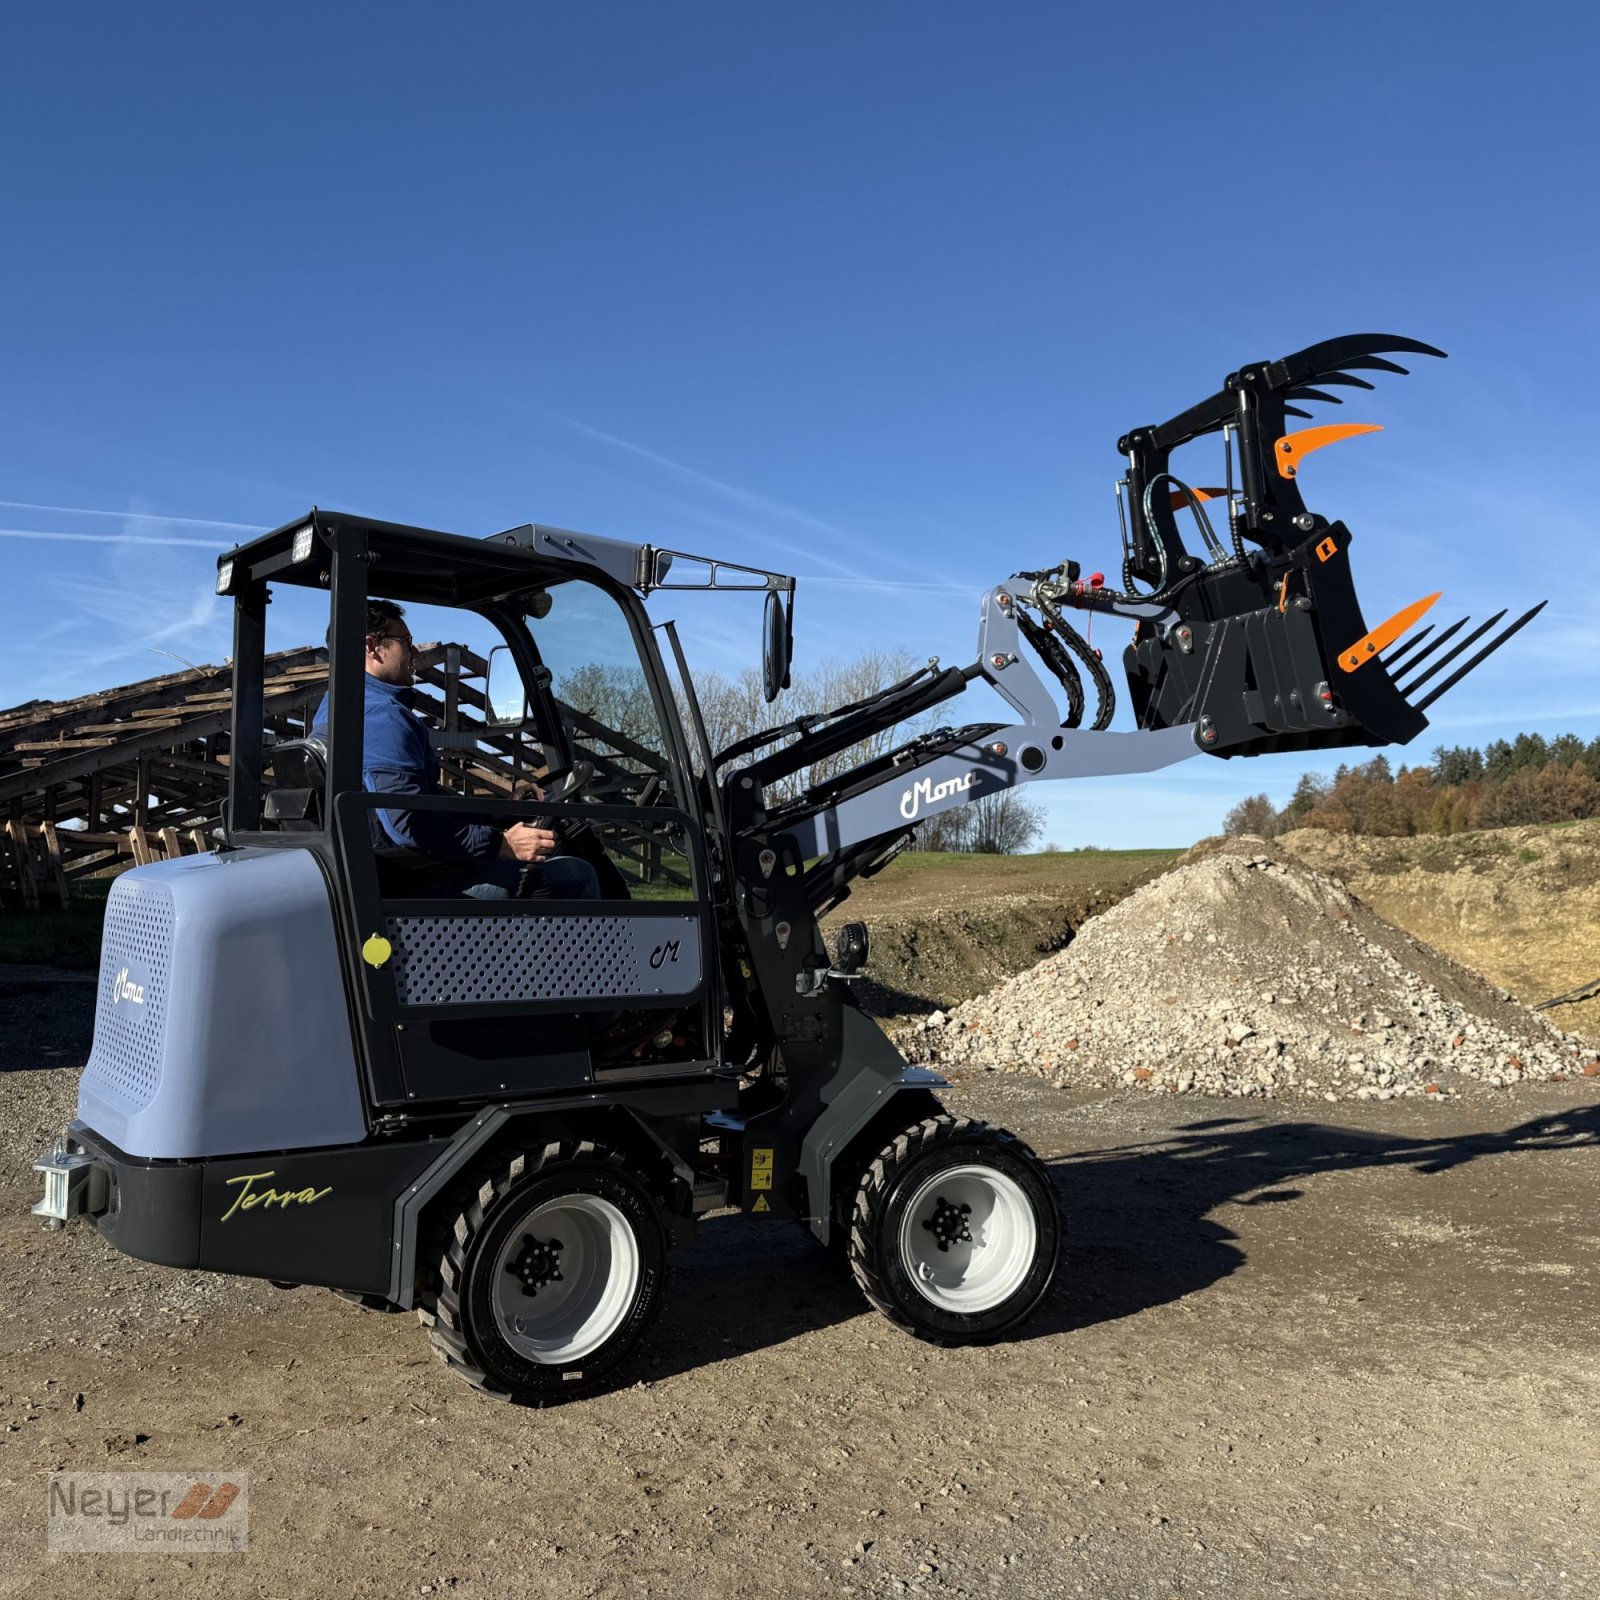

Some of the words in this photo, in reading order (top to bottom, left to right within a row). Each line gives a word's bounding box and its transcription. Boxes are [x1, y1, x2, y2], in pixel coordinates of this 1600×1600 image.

[900, 772, 982, 819] Mona
[114, 967, 144, 1004] Mona
[221, 1171, 333, 1223] Terra
